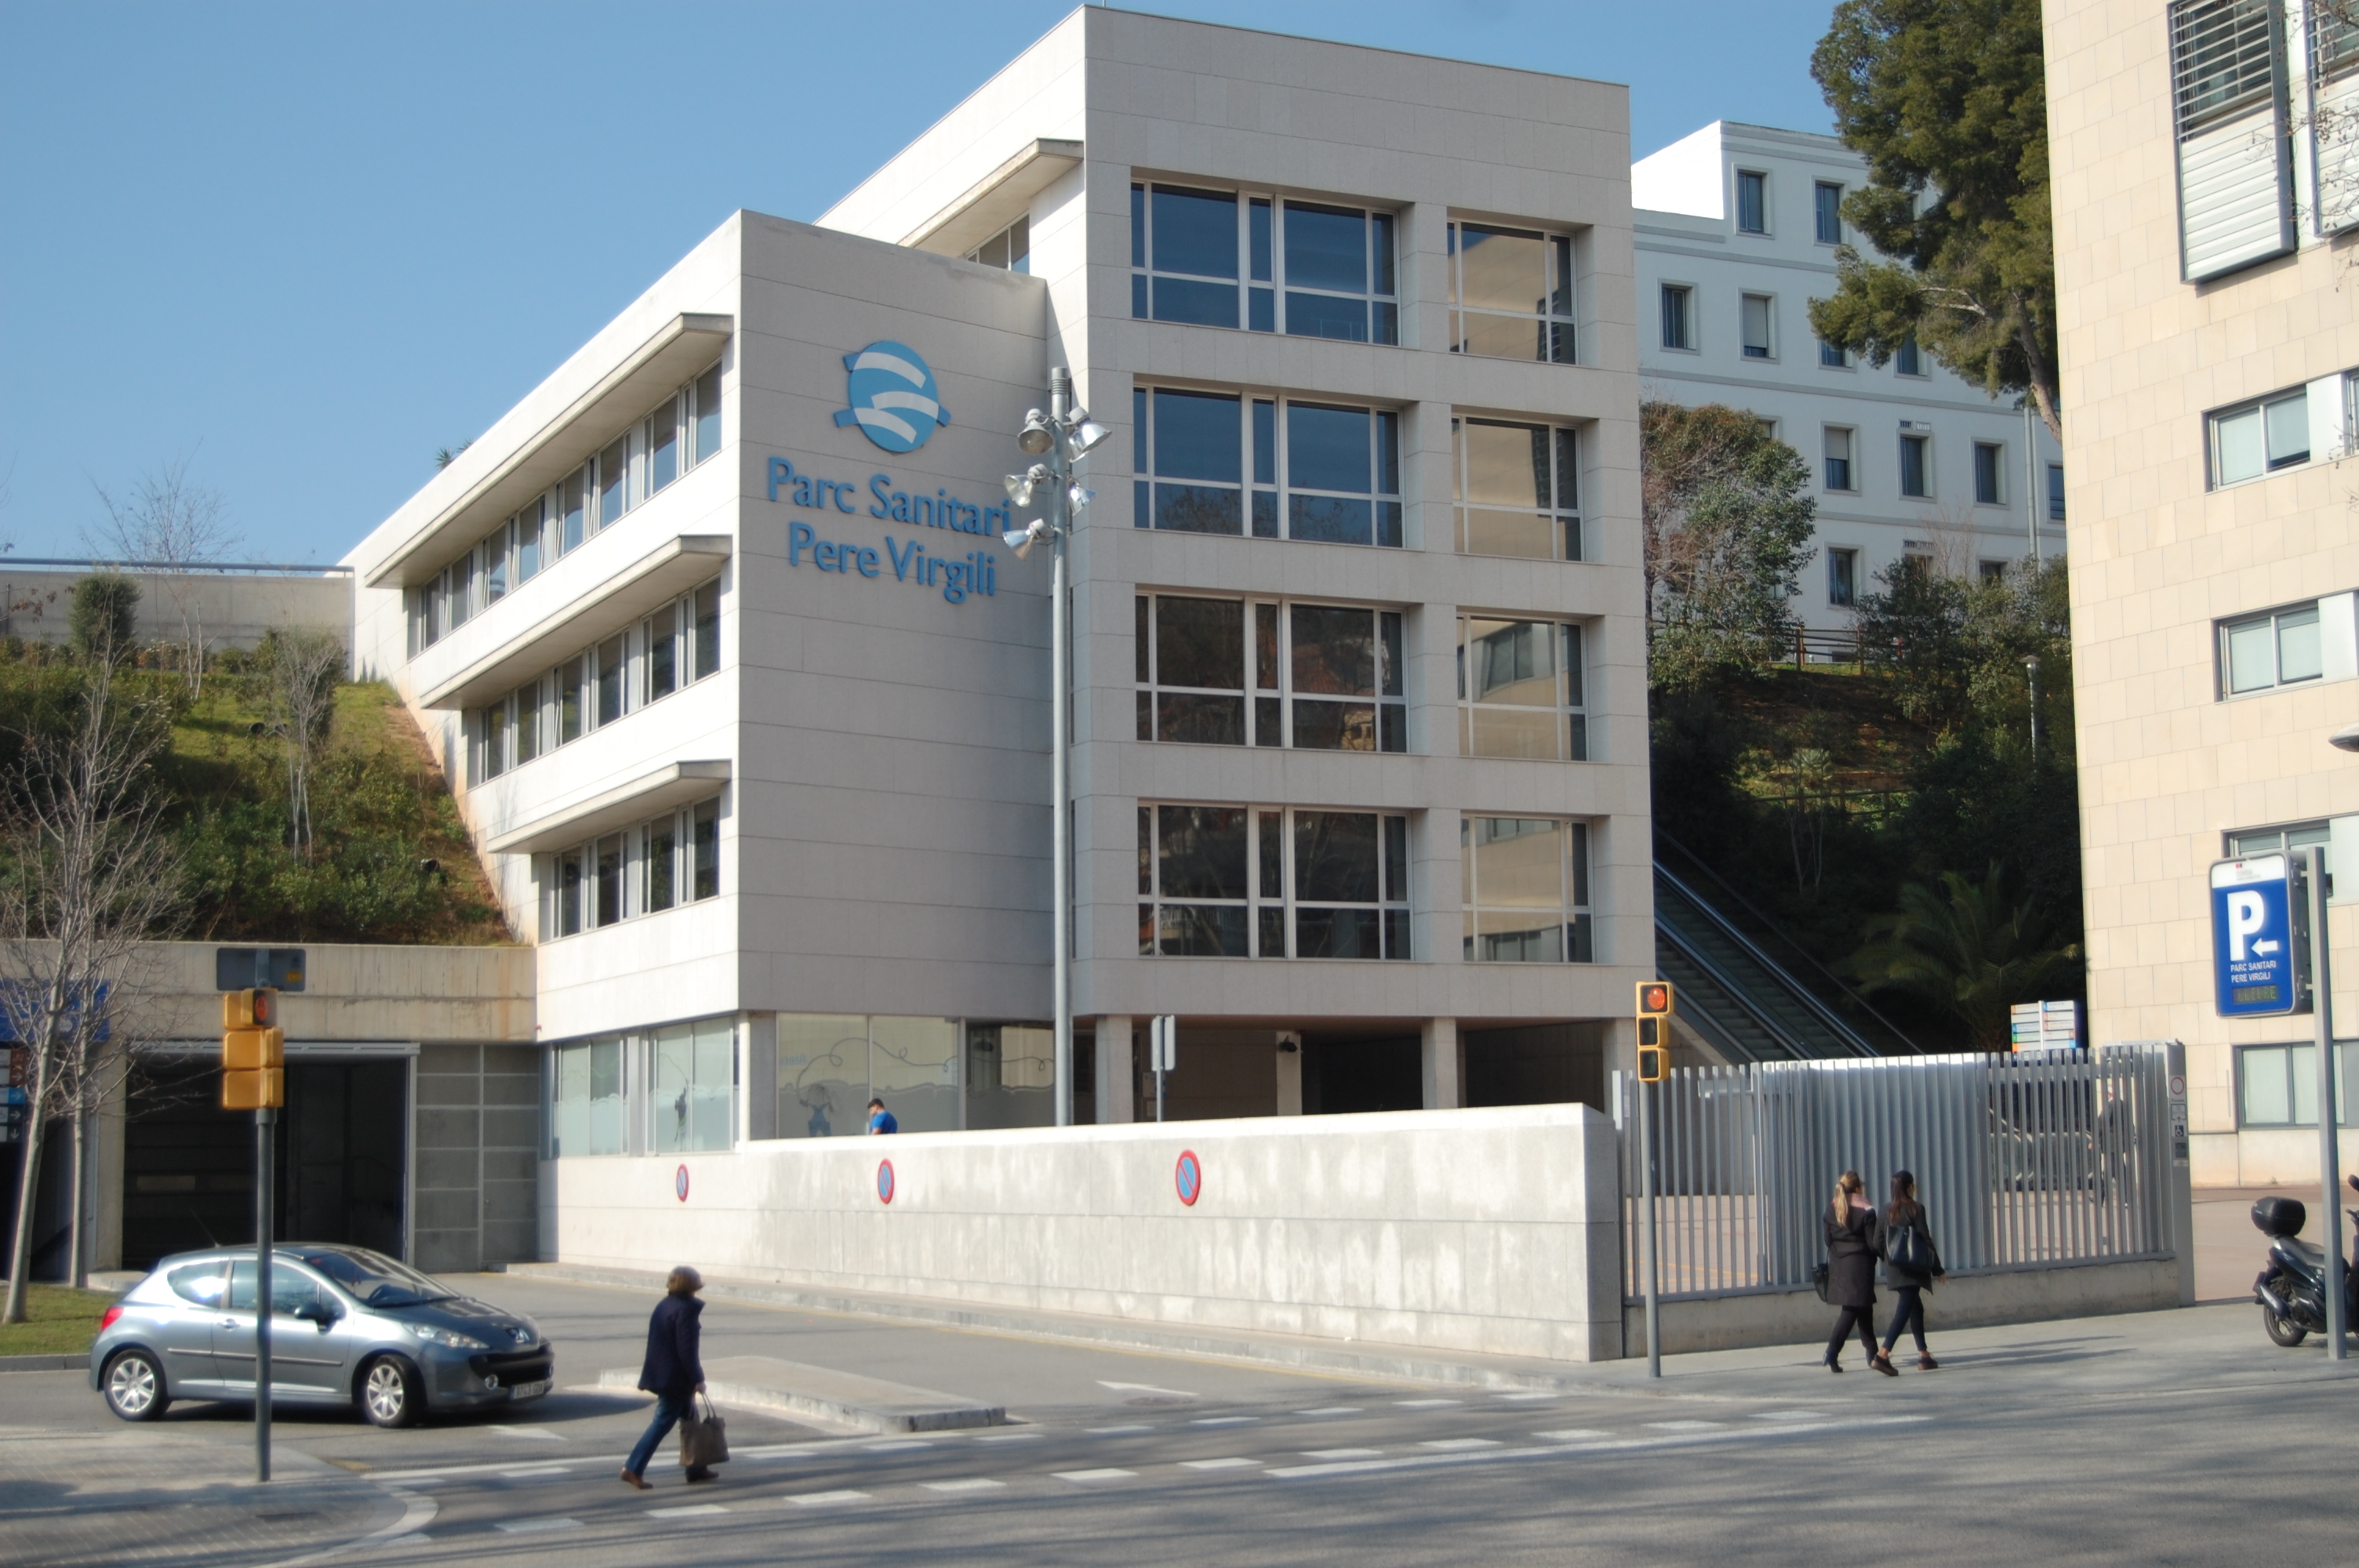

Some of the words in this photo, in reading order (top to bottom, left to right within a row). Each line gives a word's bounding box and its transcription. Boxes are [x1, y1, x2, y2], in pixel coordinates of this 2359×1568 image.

[768, 457, 856, 514] Parc
[869, 474, 1010, 536] Sanitari
[789, 521, 881, 578] Pere
[885, 536, 996, 604] Virgili
[2227, 890, 2265, 962] P
[2230, 963, 2248, 972] PARC
[2248, 960, 2277, 971] SANITARI
[2231, 973, 2248, 983] PERE
[2248, 971, 2271, 982] VIRGILI
